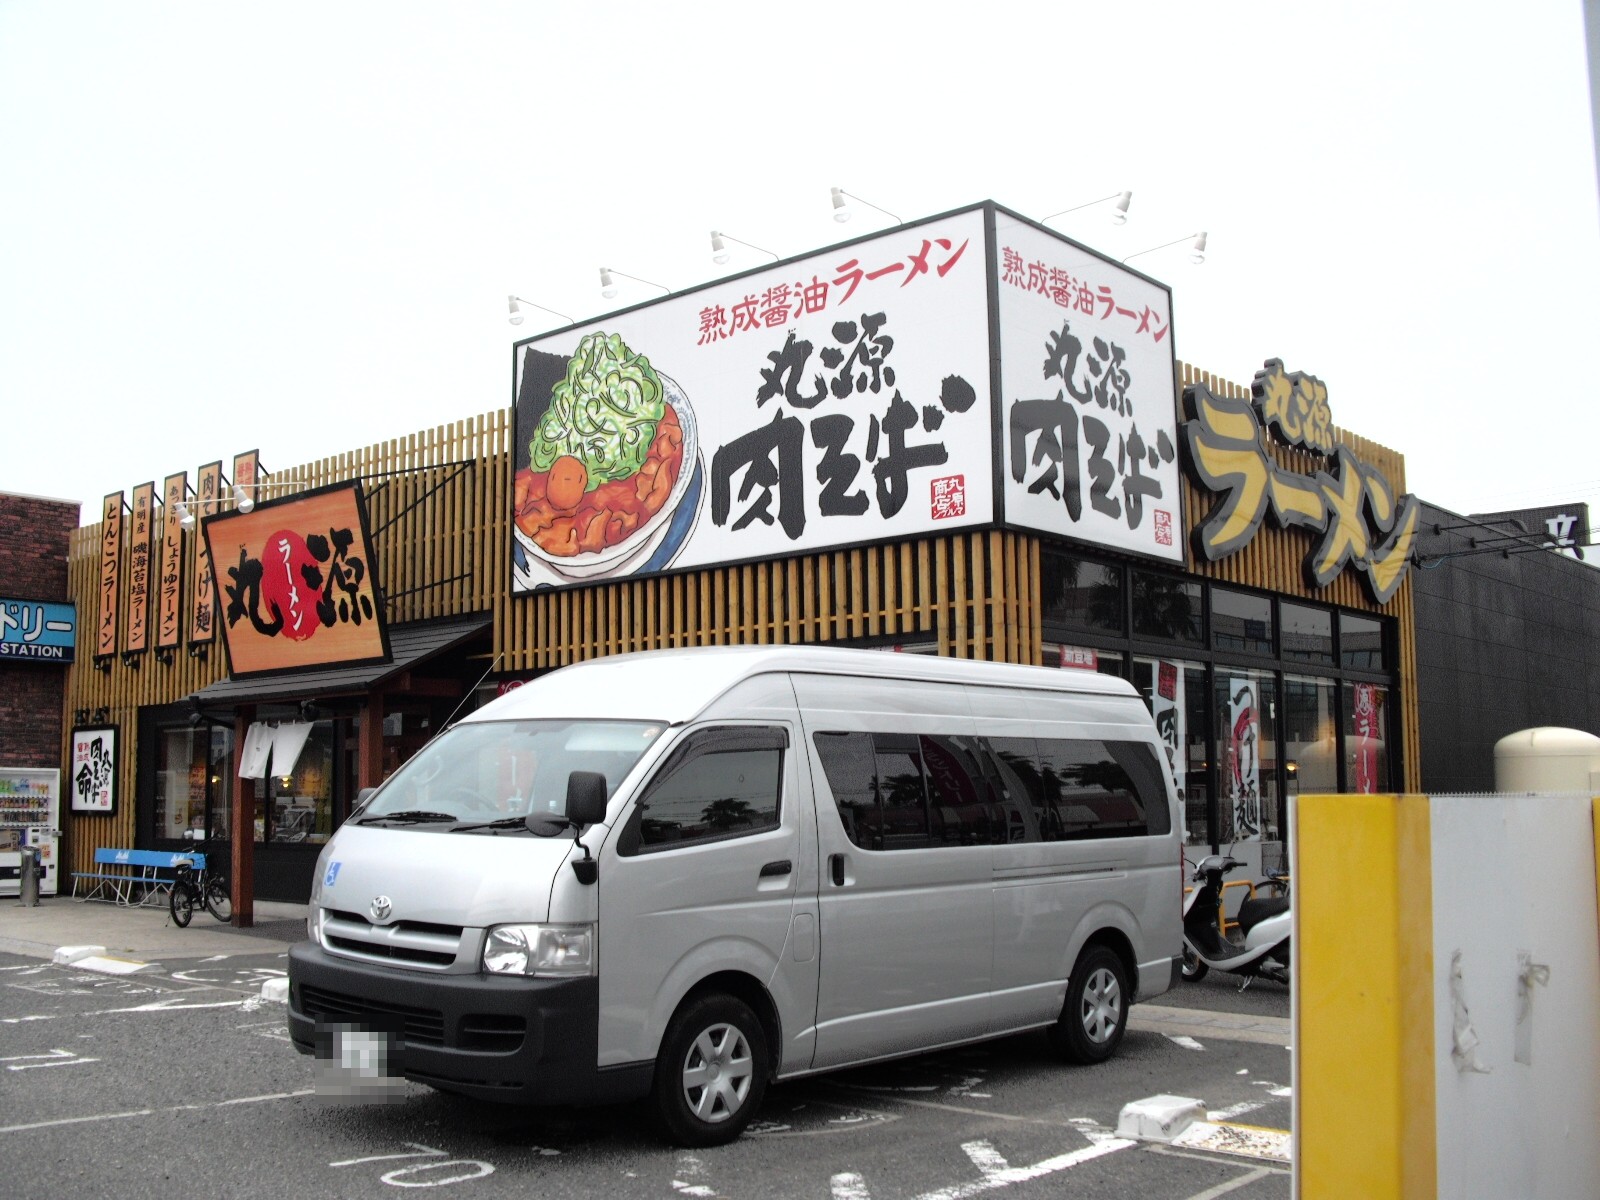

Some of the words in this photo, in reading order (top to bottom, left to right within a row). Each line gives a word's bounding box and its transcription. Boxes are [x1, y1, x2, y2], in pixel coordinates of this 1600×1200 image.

[697, 238, 969, 345] 熟成醤油ラーメン
[1002, 246, 1168, 343] 熟成醤油ラーメン
[756, 312, 895, 409] 丸源
[1043, 319, 1132, 417] 丸源
[1259, 360, 1334, 454] 丸源
[711, 375, 976, 539] 肉そば
[1010, 389, 1174, 530] 肉そば
[1188, 390, 1420, 601] ラーメン
[136, 496, 146, 534] 有明産
[101, 503, 118, 648] とんこつラーメン
[131, 542, 147, 642] 磯海苔塩ラーメン
[163, 535, 178, 637] しょうゆラーメン
[225, 527, 373, 637] 丸源
[279, 538, 303, 631] ラーメン
[0, 643, 63, 658] STATION
[76, 763, 93, 804] 命
